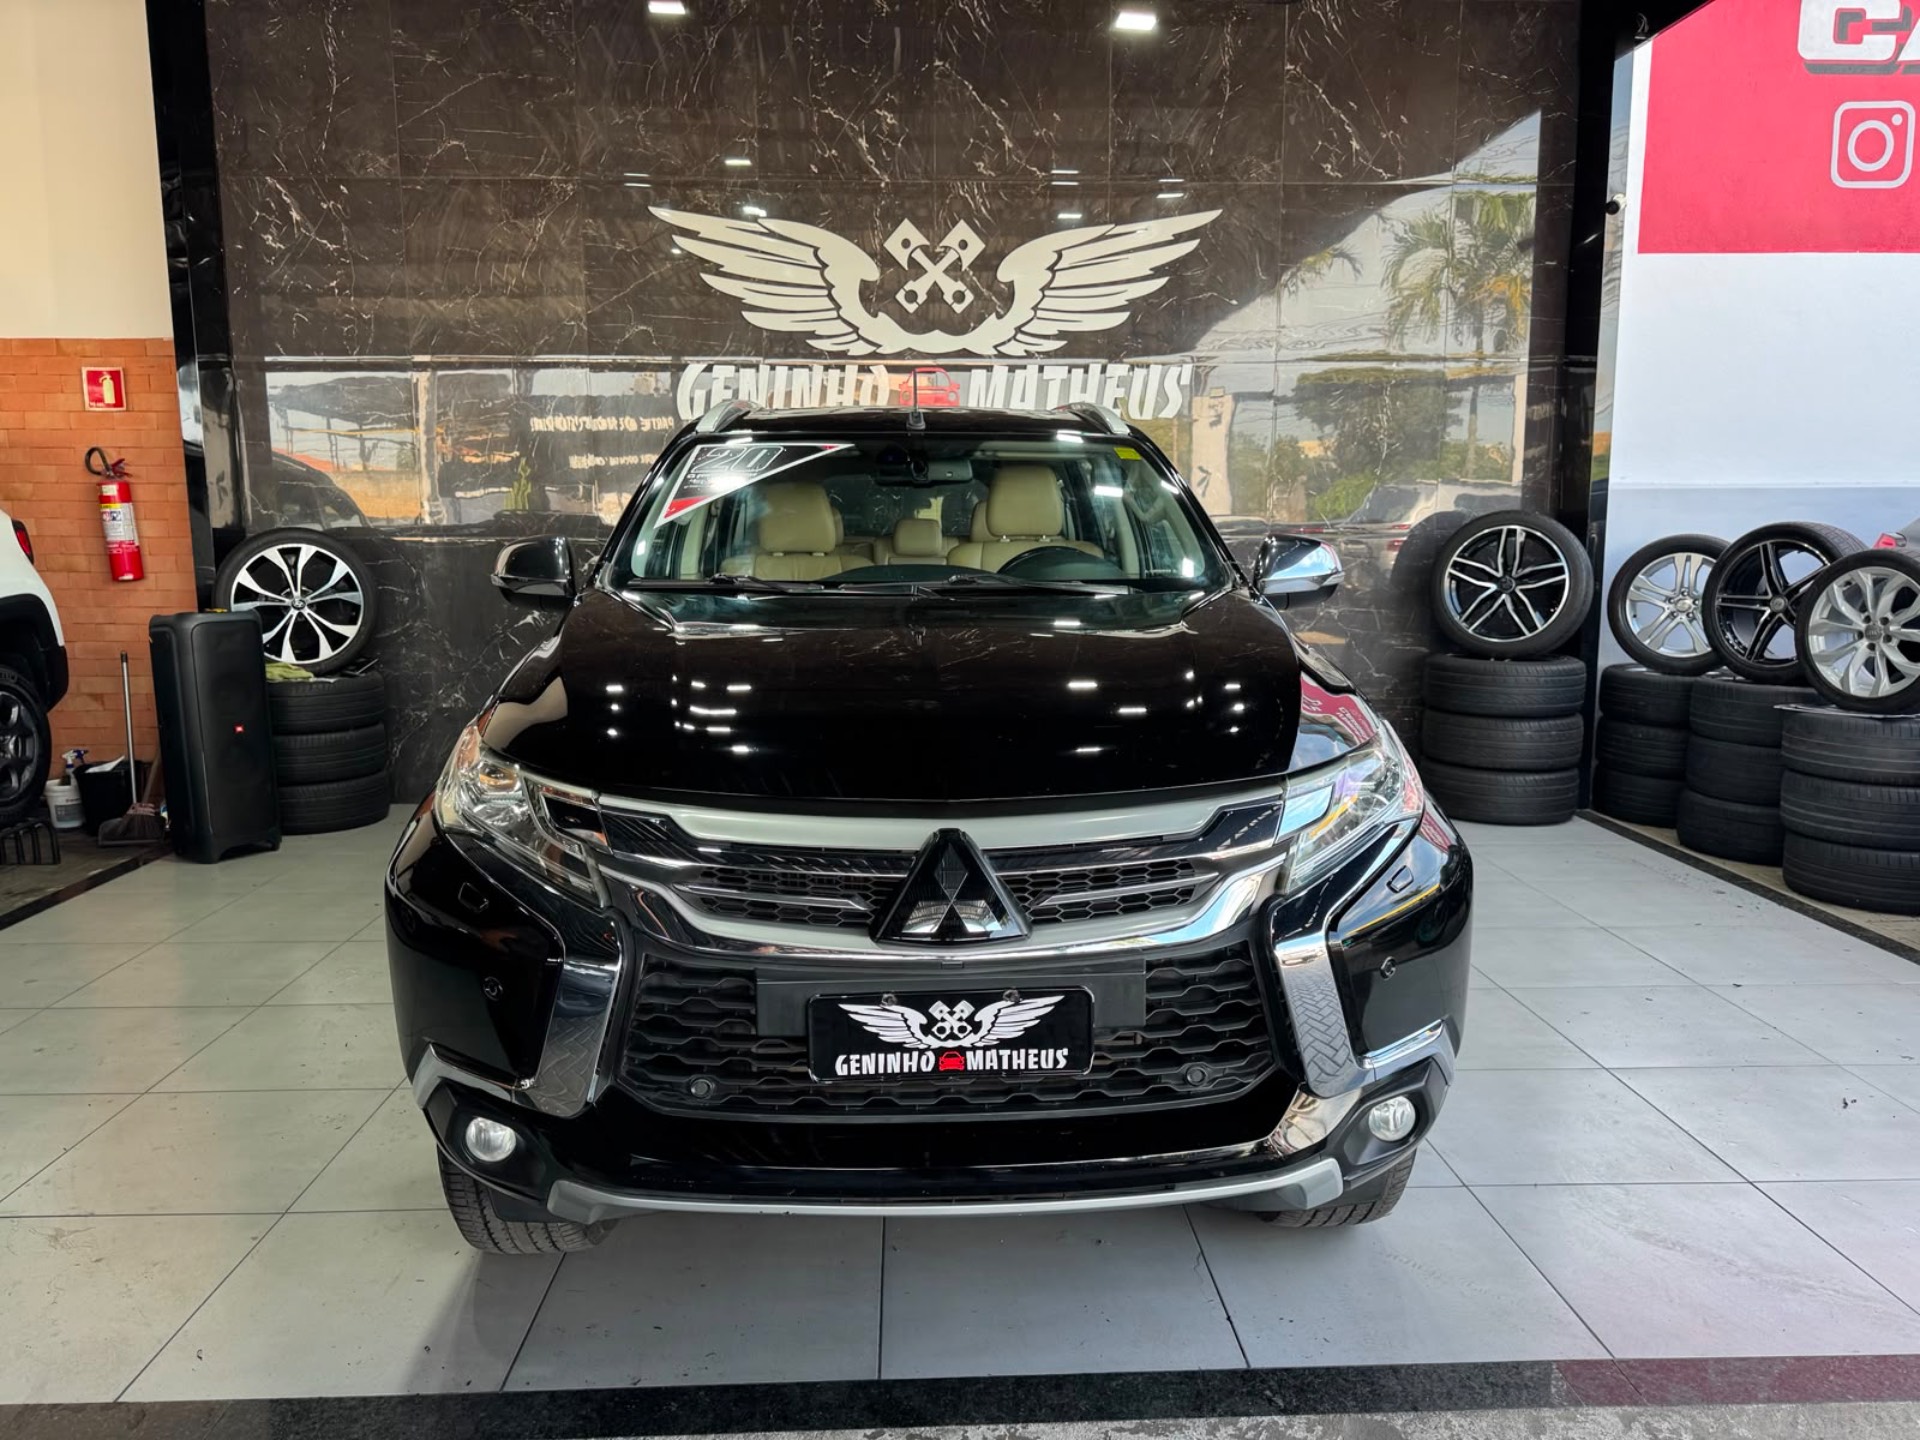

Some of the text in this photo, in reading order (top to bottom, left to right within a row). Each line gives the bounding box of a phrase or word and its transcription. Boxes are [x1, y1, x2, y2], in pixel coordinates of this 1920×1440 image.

[1797, 0, 1920, 75] C
[677, 363, 1193, 420] GENINHO MATHEUS
[835, 1048, 1069, 1076] GENINHO MATHEUS
